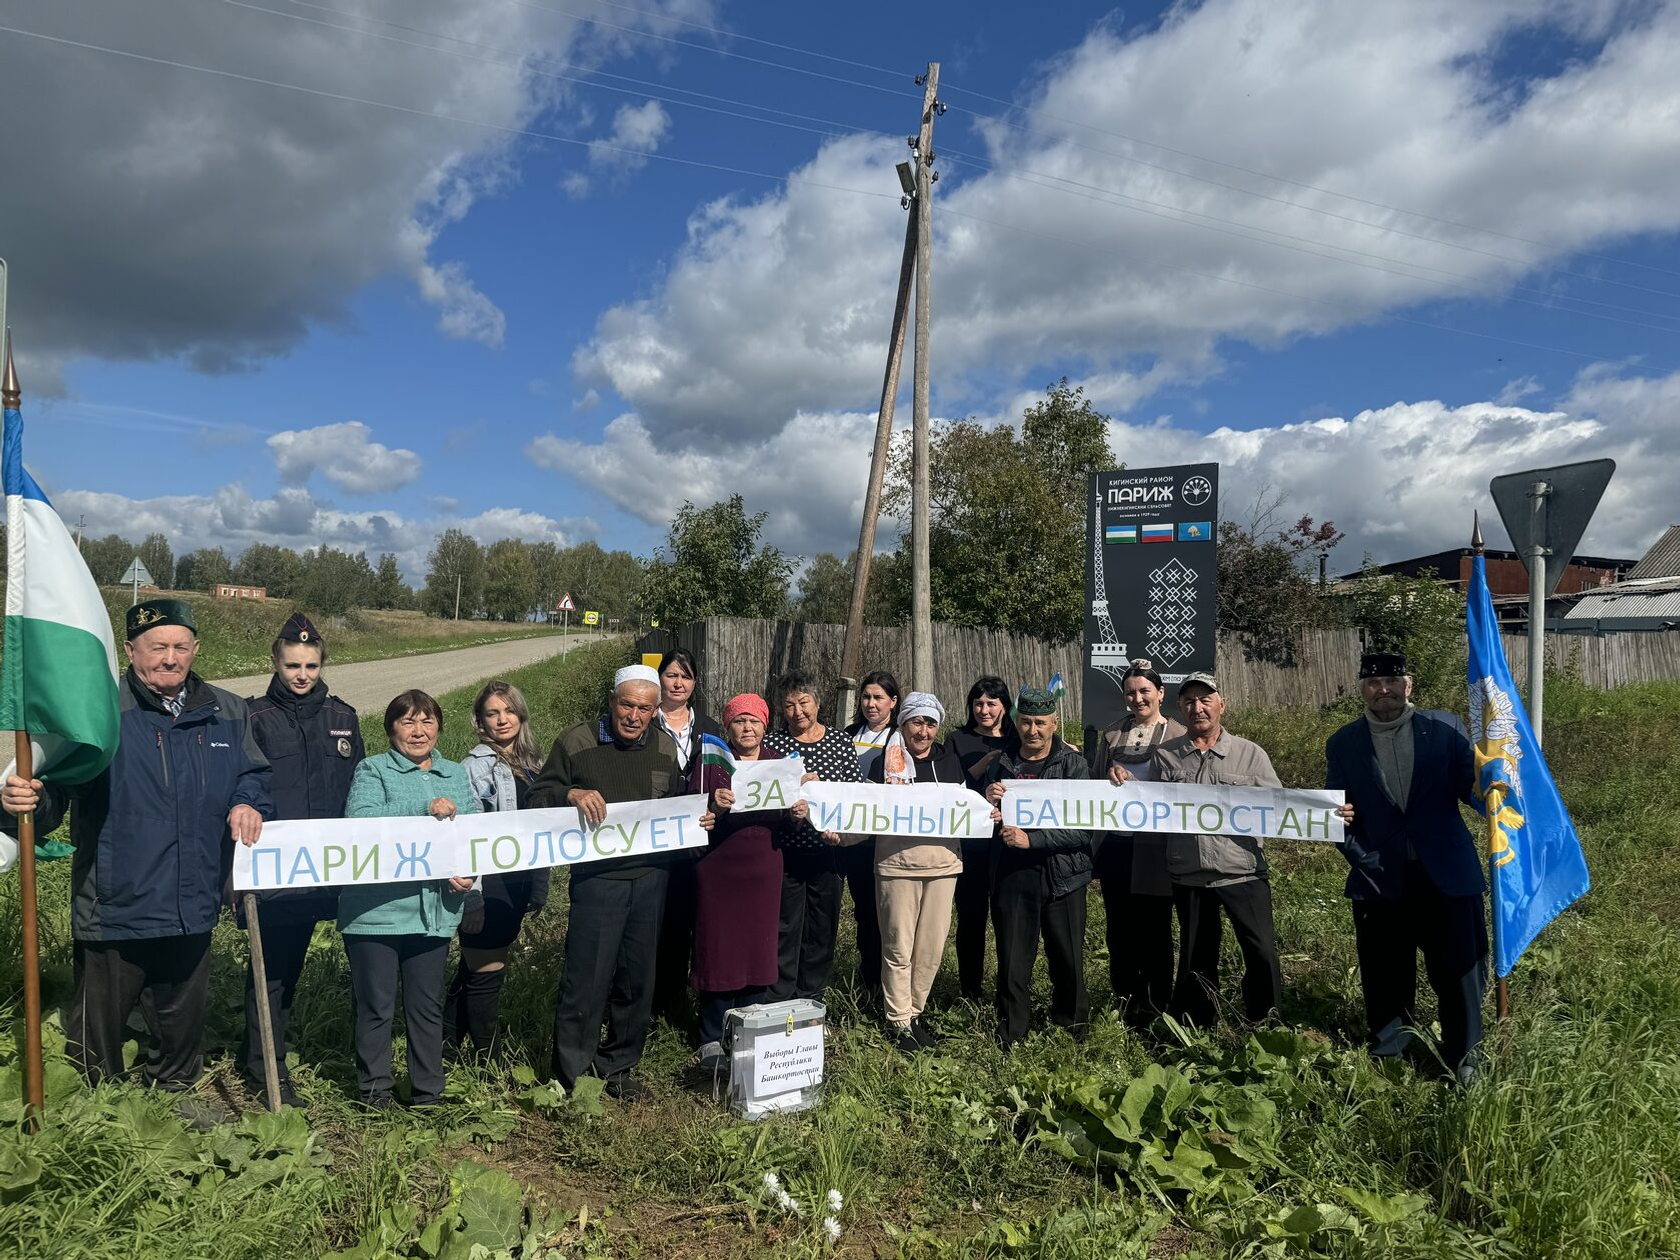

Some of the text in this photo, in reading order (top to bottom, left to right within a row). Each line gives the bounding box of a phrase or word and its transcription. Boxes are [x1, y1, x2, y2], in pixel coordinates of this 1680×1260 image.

[1109, 477, 1148, 486] КИГИНСКИЙ
[1108, 486, 1173, 503] ПАРИЖ
[744, 778, 787, 810] ЗА
[808, 800, 971, 836] ИЛЬНЫЙ
[1015, 798, 1330, 839] БАШКОРТОСТАН
[251, 813, 691, 887] ПАРИЖ ГОЛОСУЕТ
[763, 1044, 819, 1060] Выборы Главы
[769, 1056, 813, 1070] Республики
[761, 1066, 820, 1083] Башкортостан
